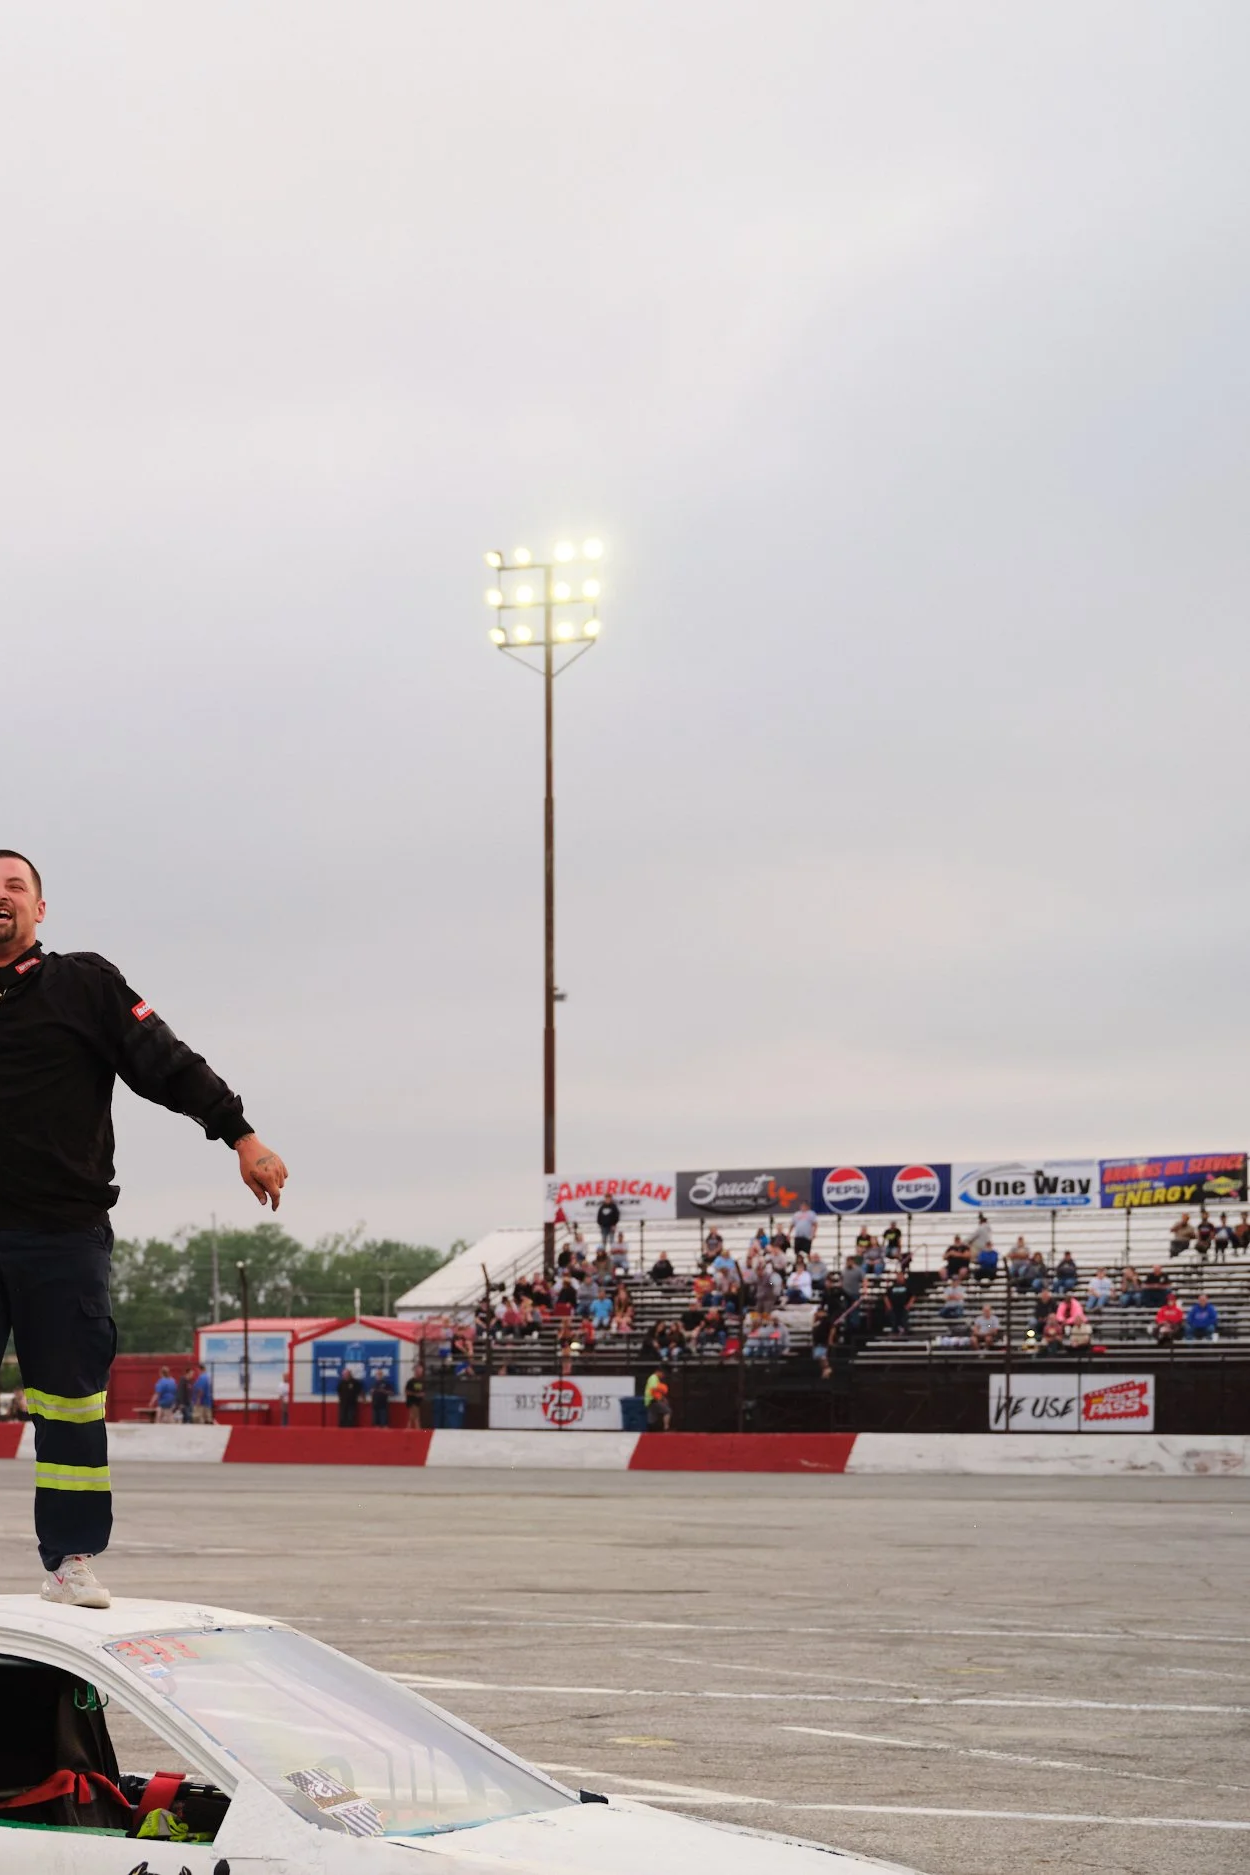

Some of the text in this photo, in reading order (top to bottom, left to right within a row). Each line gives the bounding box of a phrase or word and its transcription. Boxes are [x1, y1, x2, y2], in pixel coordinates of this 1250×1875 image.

[555, 1180, 672, 1204] AMERICAN
[689, 1172, 775, 1205] Seacat
[827, 1187, 865, 1195] PEPSI
[897, 1184, 935, 1193] PEPSI
[977, 1174, 1091, 1197] One Way
[1113, 1185, 1197, 1208] ENERGY
[1031, 1397, 1077, 1418] USE
